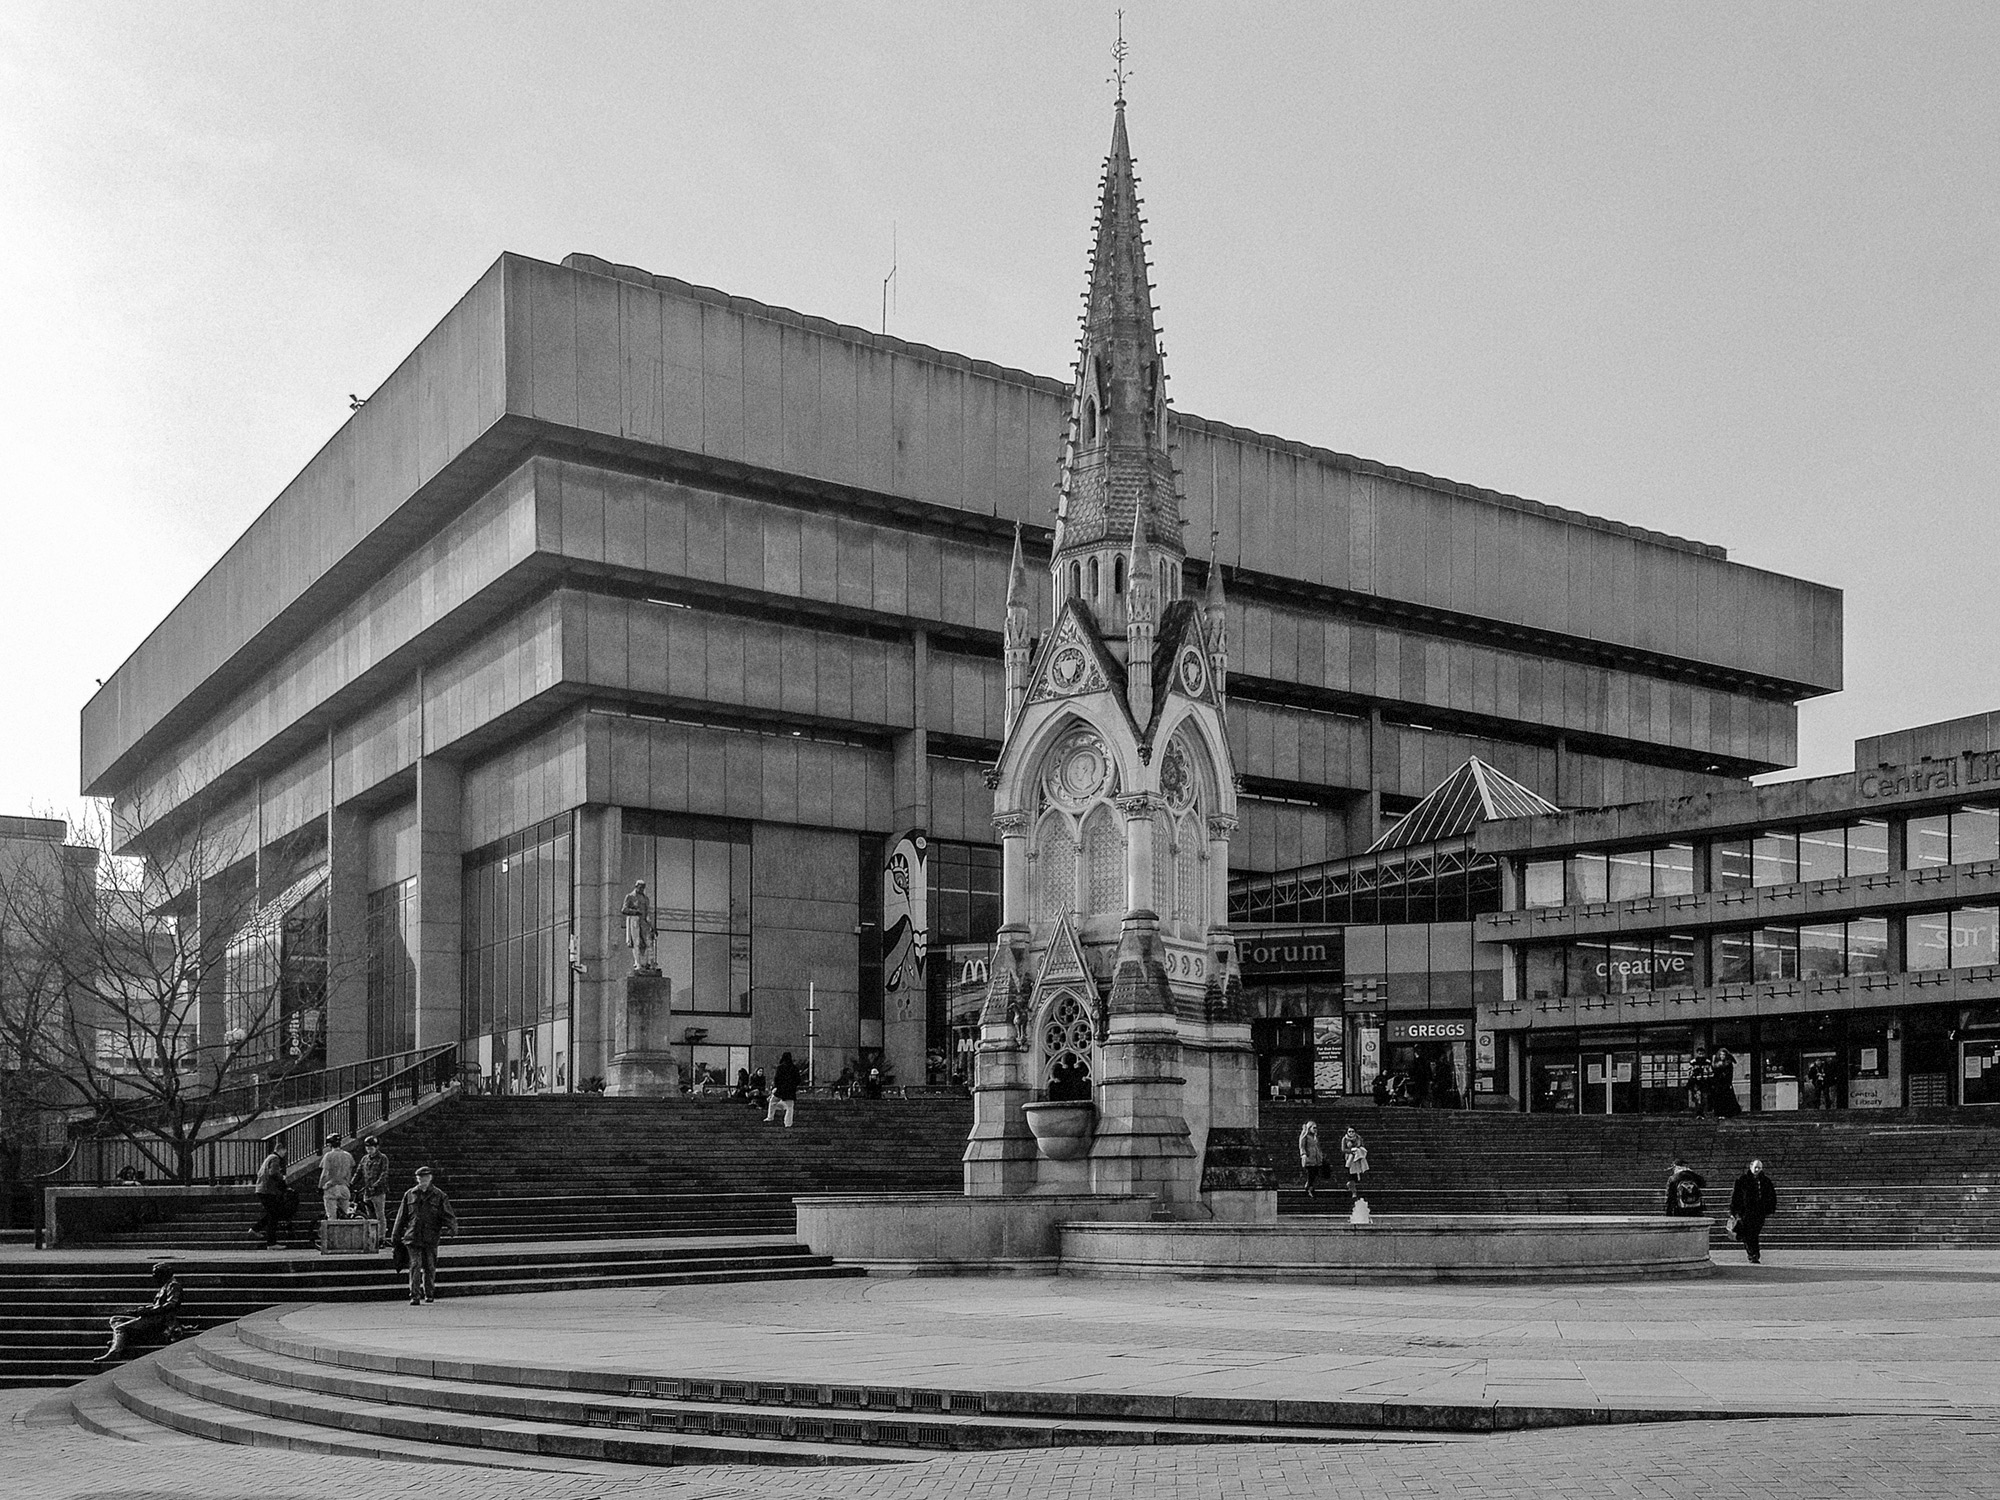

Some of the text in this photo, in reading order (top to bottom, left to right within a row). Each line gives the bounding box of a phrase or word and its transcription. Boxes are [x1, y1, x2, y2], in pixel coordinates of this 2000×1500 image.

[1861, 760, 1958, 799] Central
[1237, 941, 1327, 964] Forum
[1595, 954, 1685, 977] creative
[1408, 1023, 1466, 1037] GREGGS
[1850, 1089, 1878, 1098] Central
